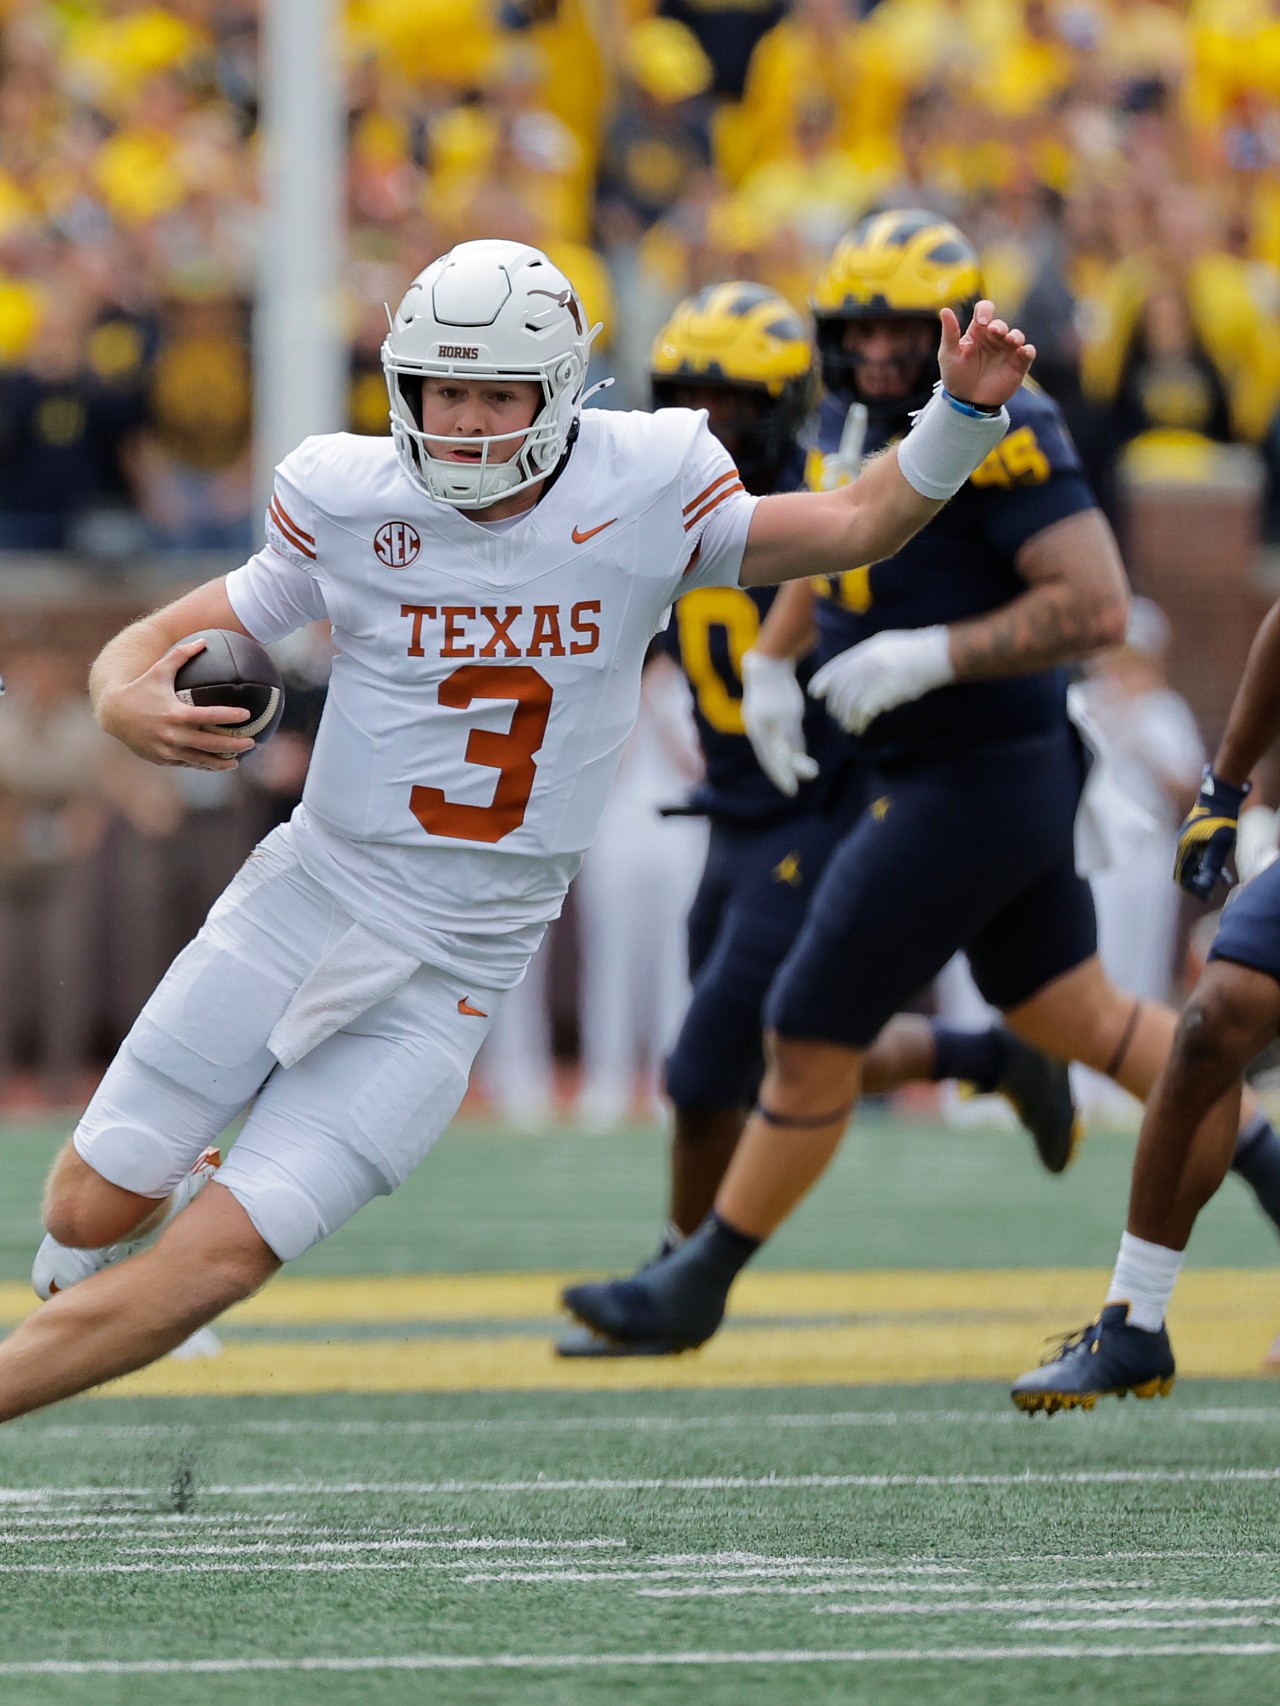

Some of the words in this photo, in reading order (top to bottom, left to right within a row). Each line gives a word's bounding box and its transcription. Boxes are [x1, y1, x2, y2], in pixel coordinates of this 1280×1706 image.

[438, 345, 479, 360] HORNS
[375, 523, 419, 567] SEC
[400, 600, 601, 658] TEXAS
[409, 665, 553, 843] 3
